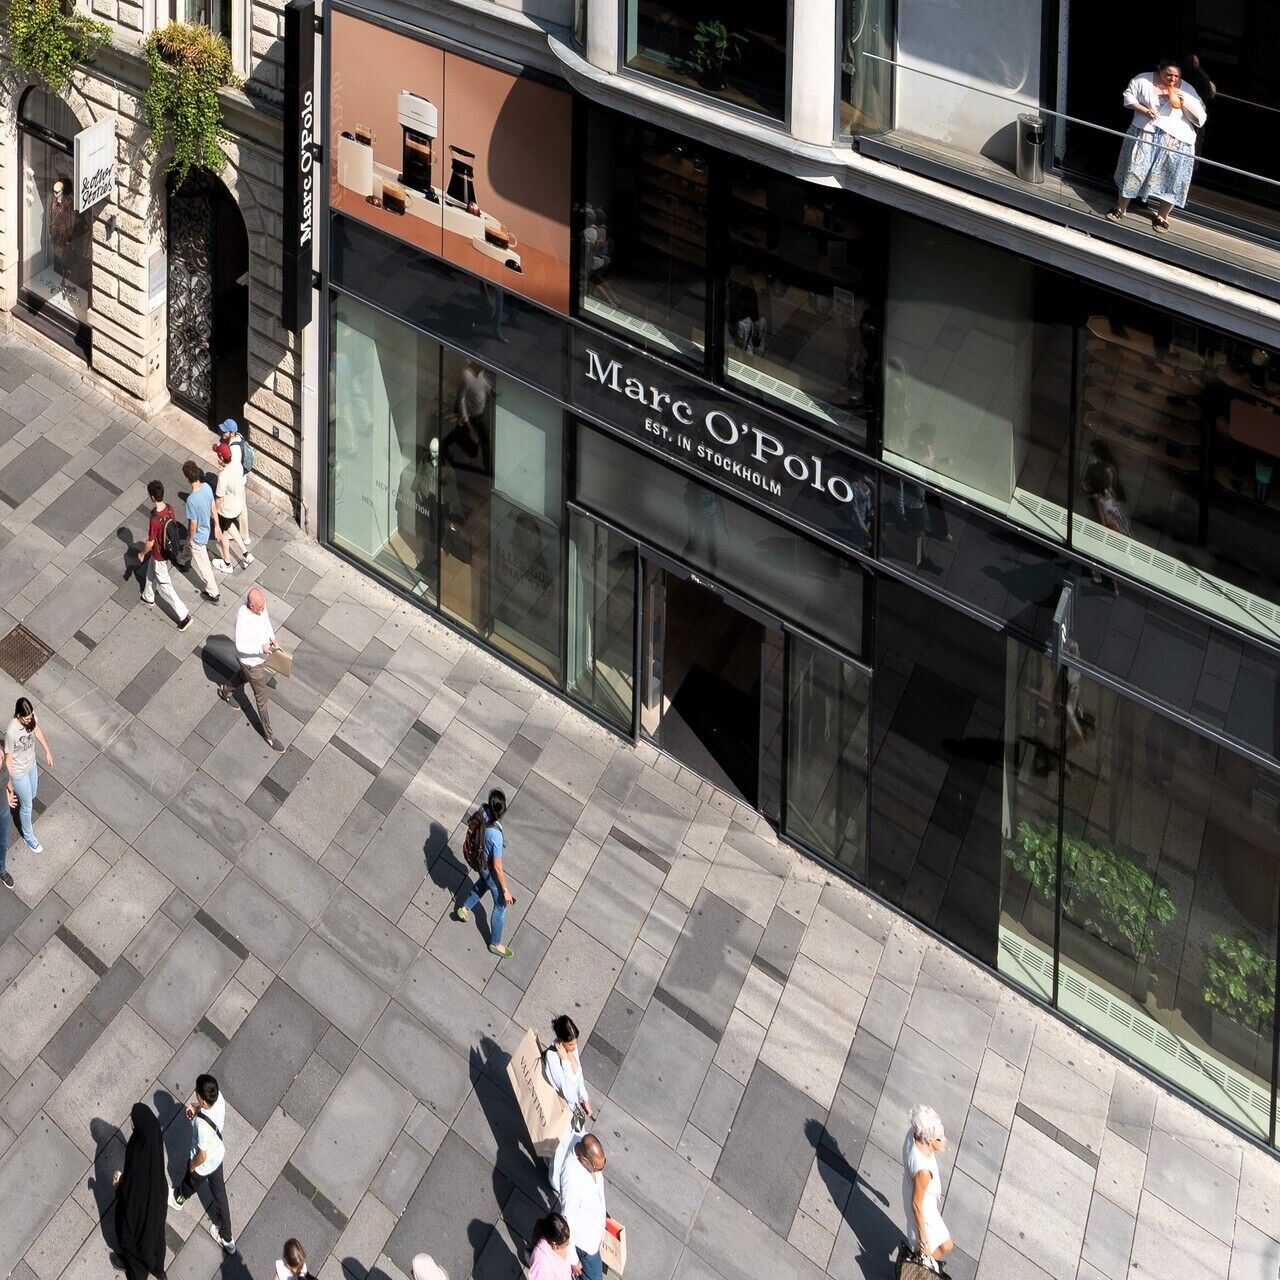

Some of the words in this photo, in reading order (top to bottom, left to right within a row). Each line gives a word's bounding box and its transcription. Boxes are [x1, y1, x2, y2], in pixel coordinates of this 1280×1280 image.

[300, 90, 313, 173] O'Polo
[300, 175, 313, 247] Marc
[584, 348, 694, 426] Marc
[705, 409, 854, 503] O'Polo
[644, 417, 673, 443] EST.
[677, 434, 692, 452] IN
[696, 443, 782, 497] STOCKHOLM
[520, 1055, 547, 1127] VALENTINO
